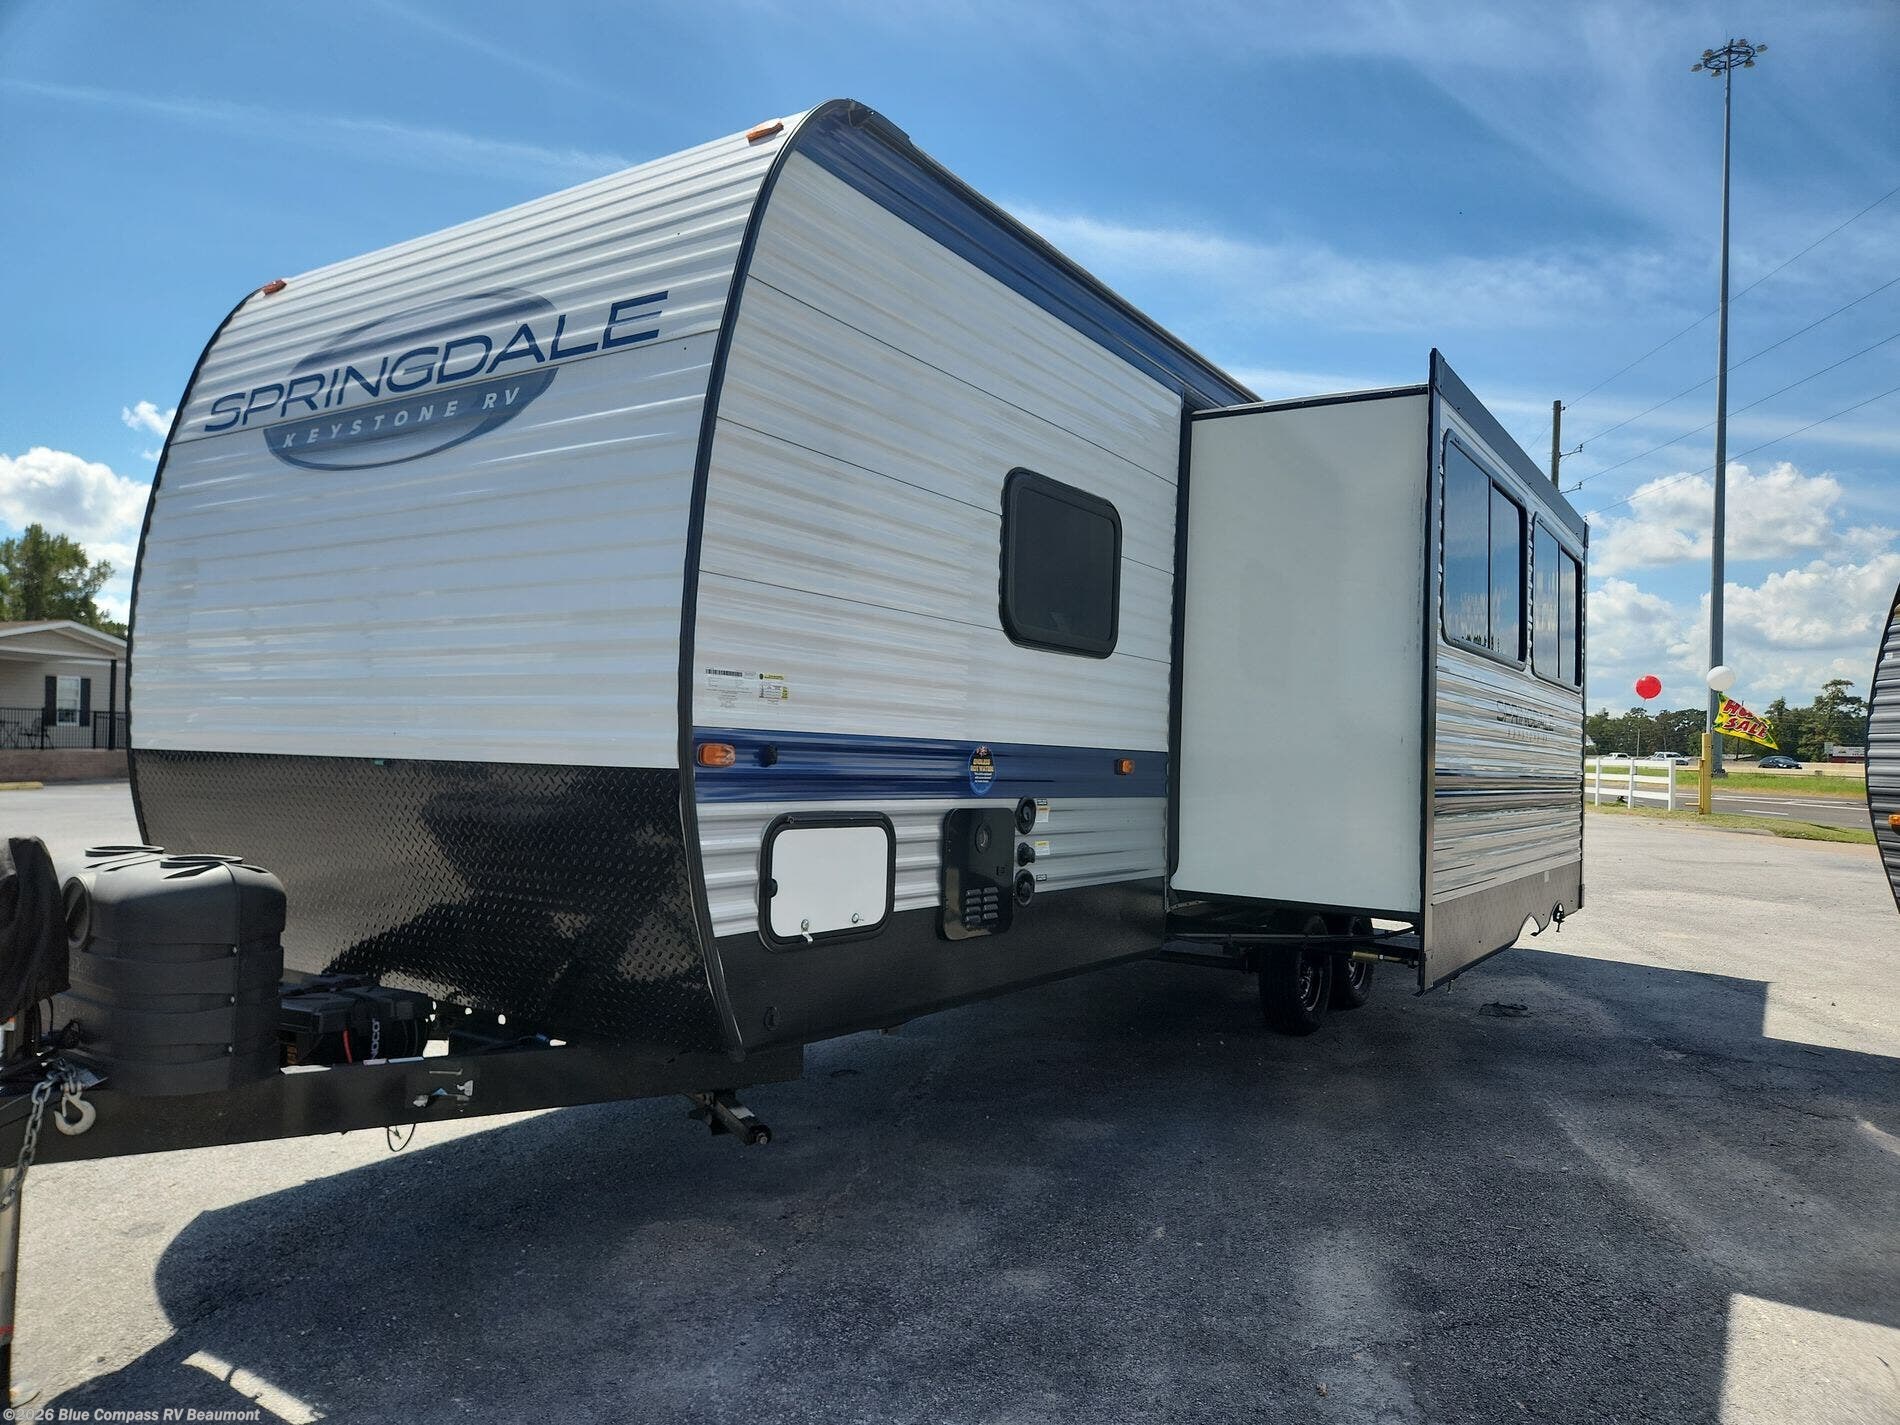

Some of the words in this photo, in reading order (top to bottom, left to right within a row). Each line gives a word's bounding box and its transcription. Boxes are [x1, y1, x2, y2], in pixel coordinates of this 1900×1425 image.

[204, 290, 669, 433] SPRINGDALE
[281, 400, 460, 449] KEYSTONE
[481, 386, 521, 410] RV
